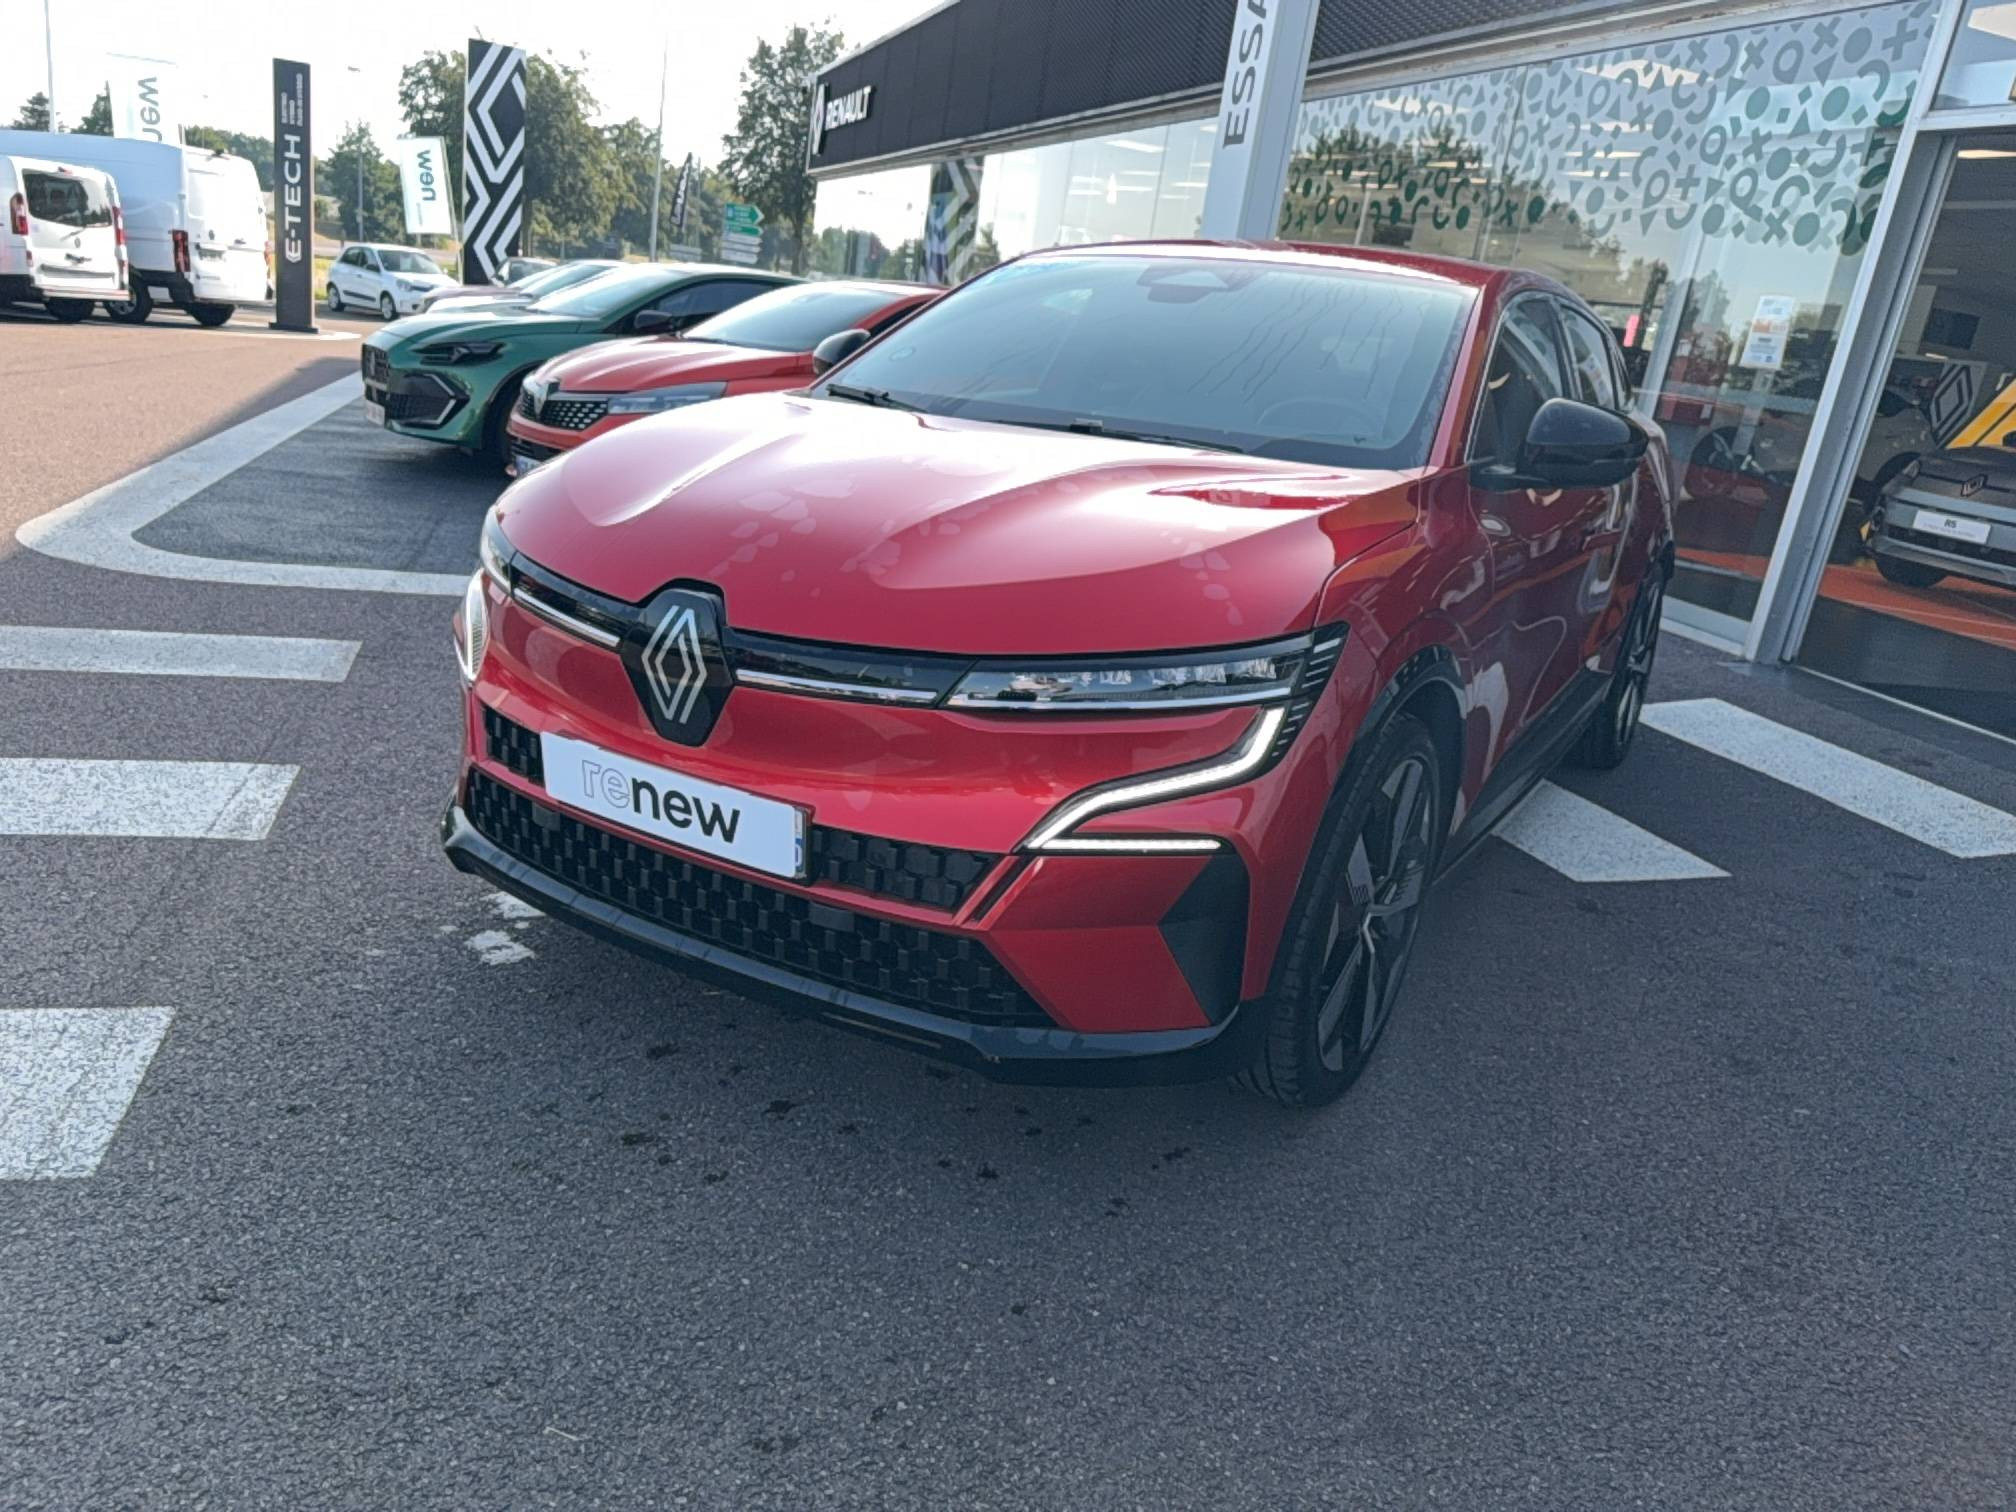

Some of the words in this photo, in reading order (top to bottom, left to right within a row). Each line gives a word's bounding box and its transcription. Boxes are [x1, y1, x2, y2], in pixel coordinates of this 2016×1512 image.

[825, 85, 872, 131] RENAULT
[283, 134, 302, 263] E-TECH
[581, 759, 741, 844] renew
